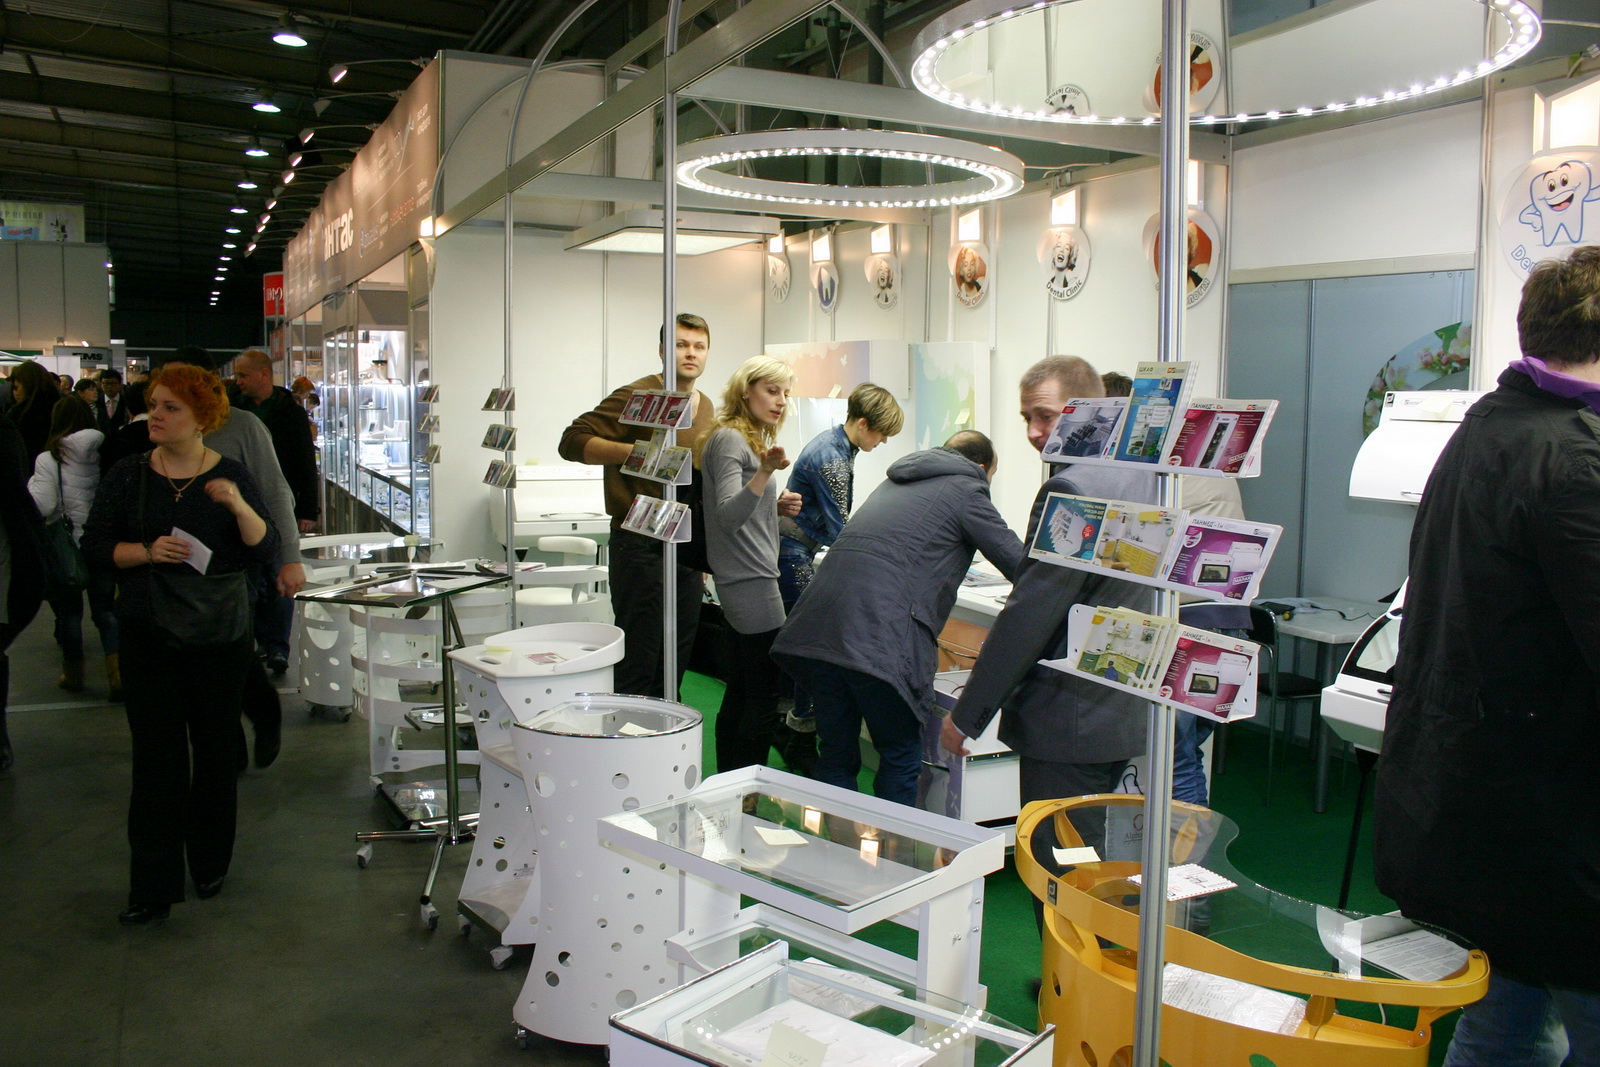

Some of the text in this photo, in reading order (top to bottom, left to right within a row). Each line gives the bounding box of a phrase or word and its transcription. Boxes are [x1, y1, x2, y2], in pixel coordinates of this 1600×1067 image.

[1046, 280, 1083, 298] Dental Clinic
[956, 290, 985, 307] Dental Clinic
